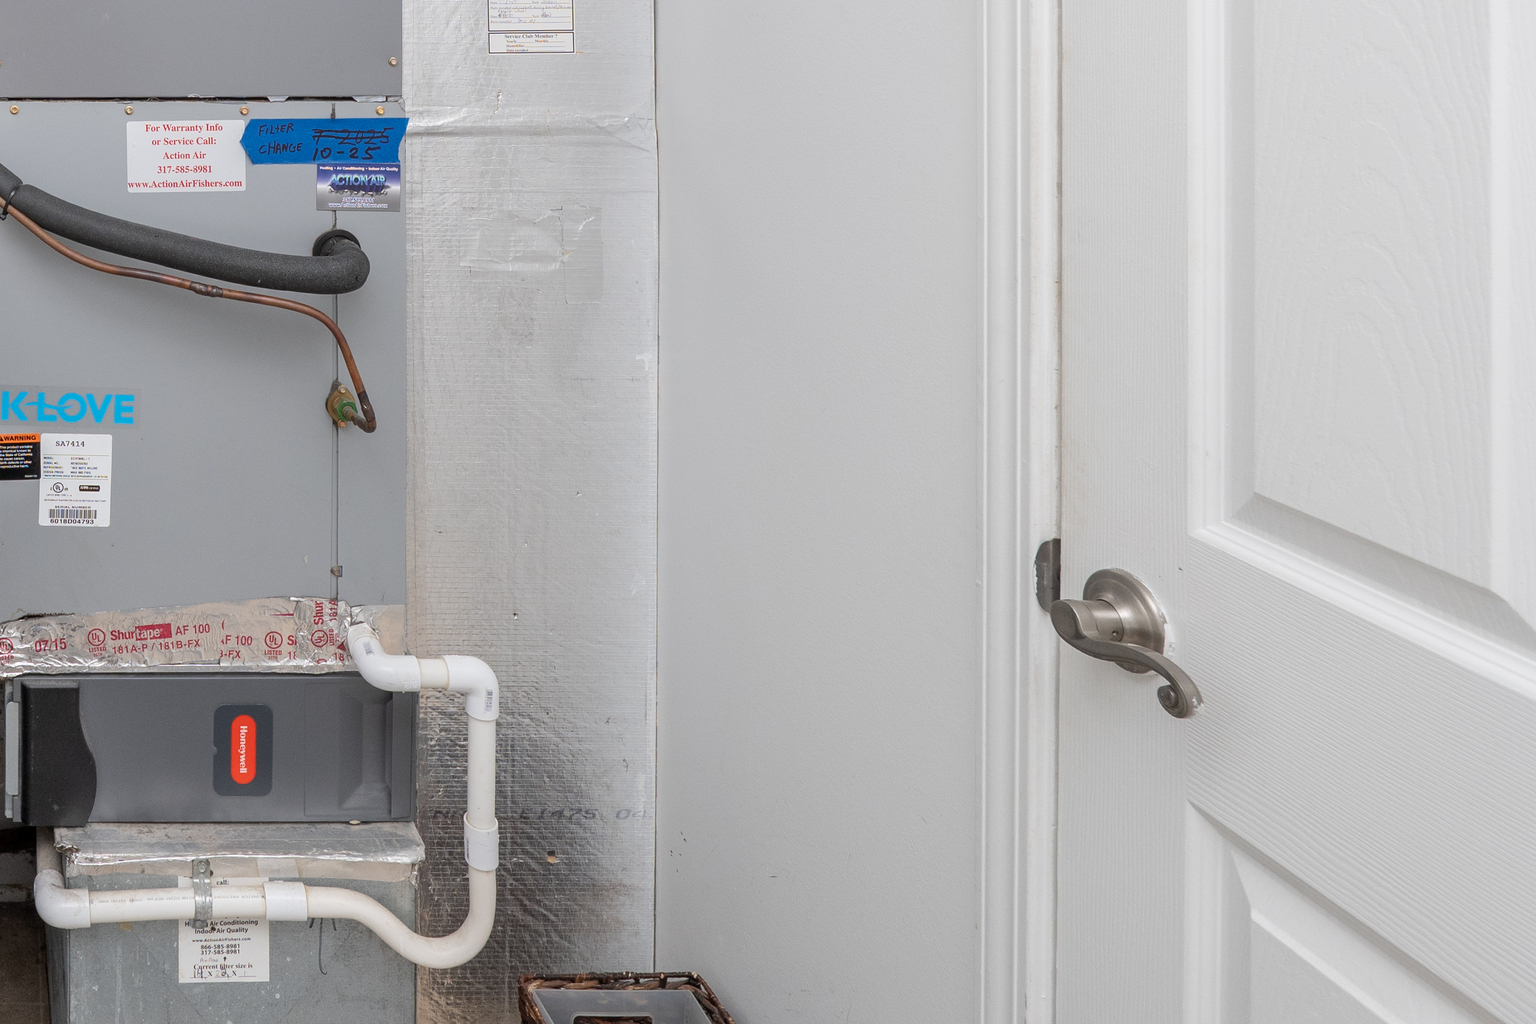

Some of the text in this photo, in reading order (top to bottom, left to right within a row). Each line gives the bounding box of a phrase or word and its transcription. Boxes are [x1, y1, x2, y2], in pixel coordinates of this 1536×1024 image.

[145, 123, 223, 133] For Warranty Info
[163, 137, 194, 146] Service
[196, 137, 216, 145] Call:
[258, 140, 303, 155] CHANGE
[163, 151, 207, 160] Action Air
[157, 165, 212, 174] 317-585-8981
[128, 179, 242, 188] www.ActionAirFishers.com
[330, 174, 386, 186] ACTION AIR
[91, 632, 102, 643] UL
[110, 624, 210, 641] Shurtape AF 100
[235, 635, 253, 646] 100
[269, 634, 279, 645] UL
[315, 633, 325, 644] UL
[34, 638, 67, 653] 07/15
[112, 643, 148, 655] 181A-P
[159, 639, 200, 650] 181B-FX
[238, 726, 248, 773] Honeywell
[216, 878, 229, 886] call:
